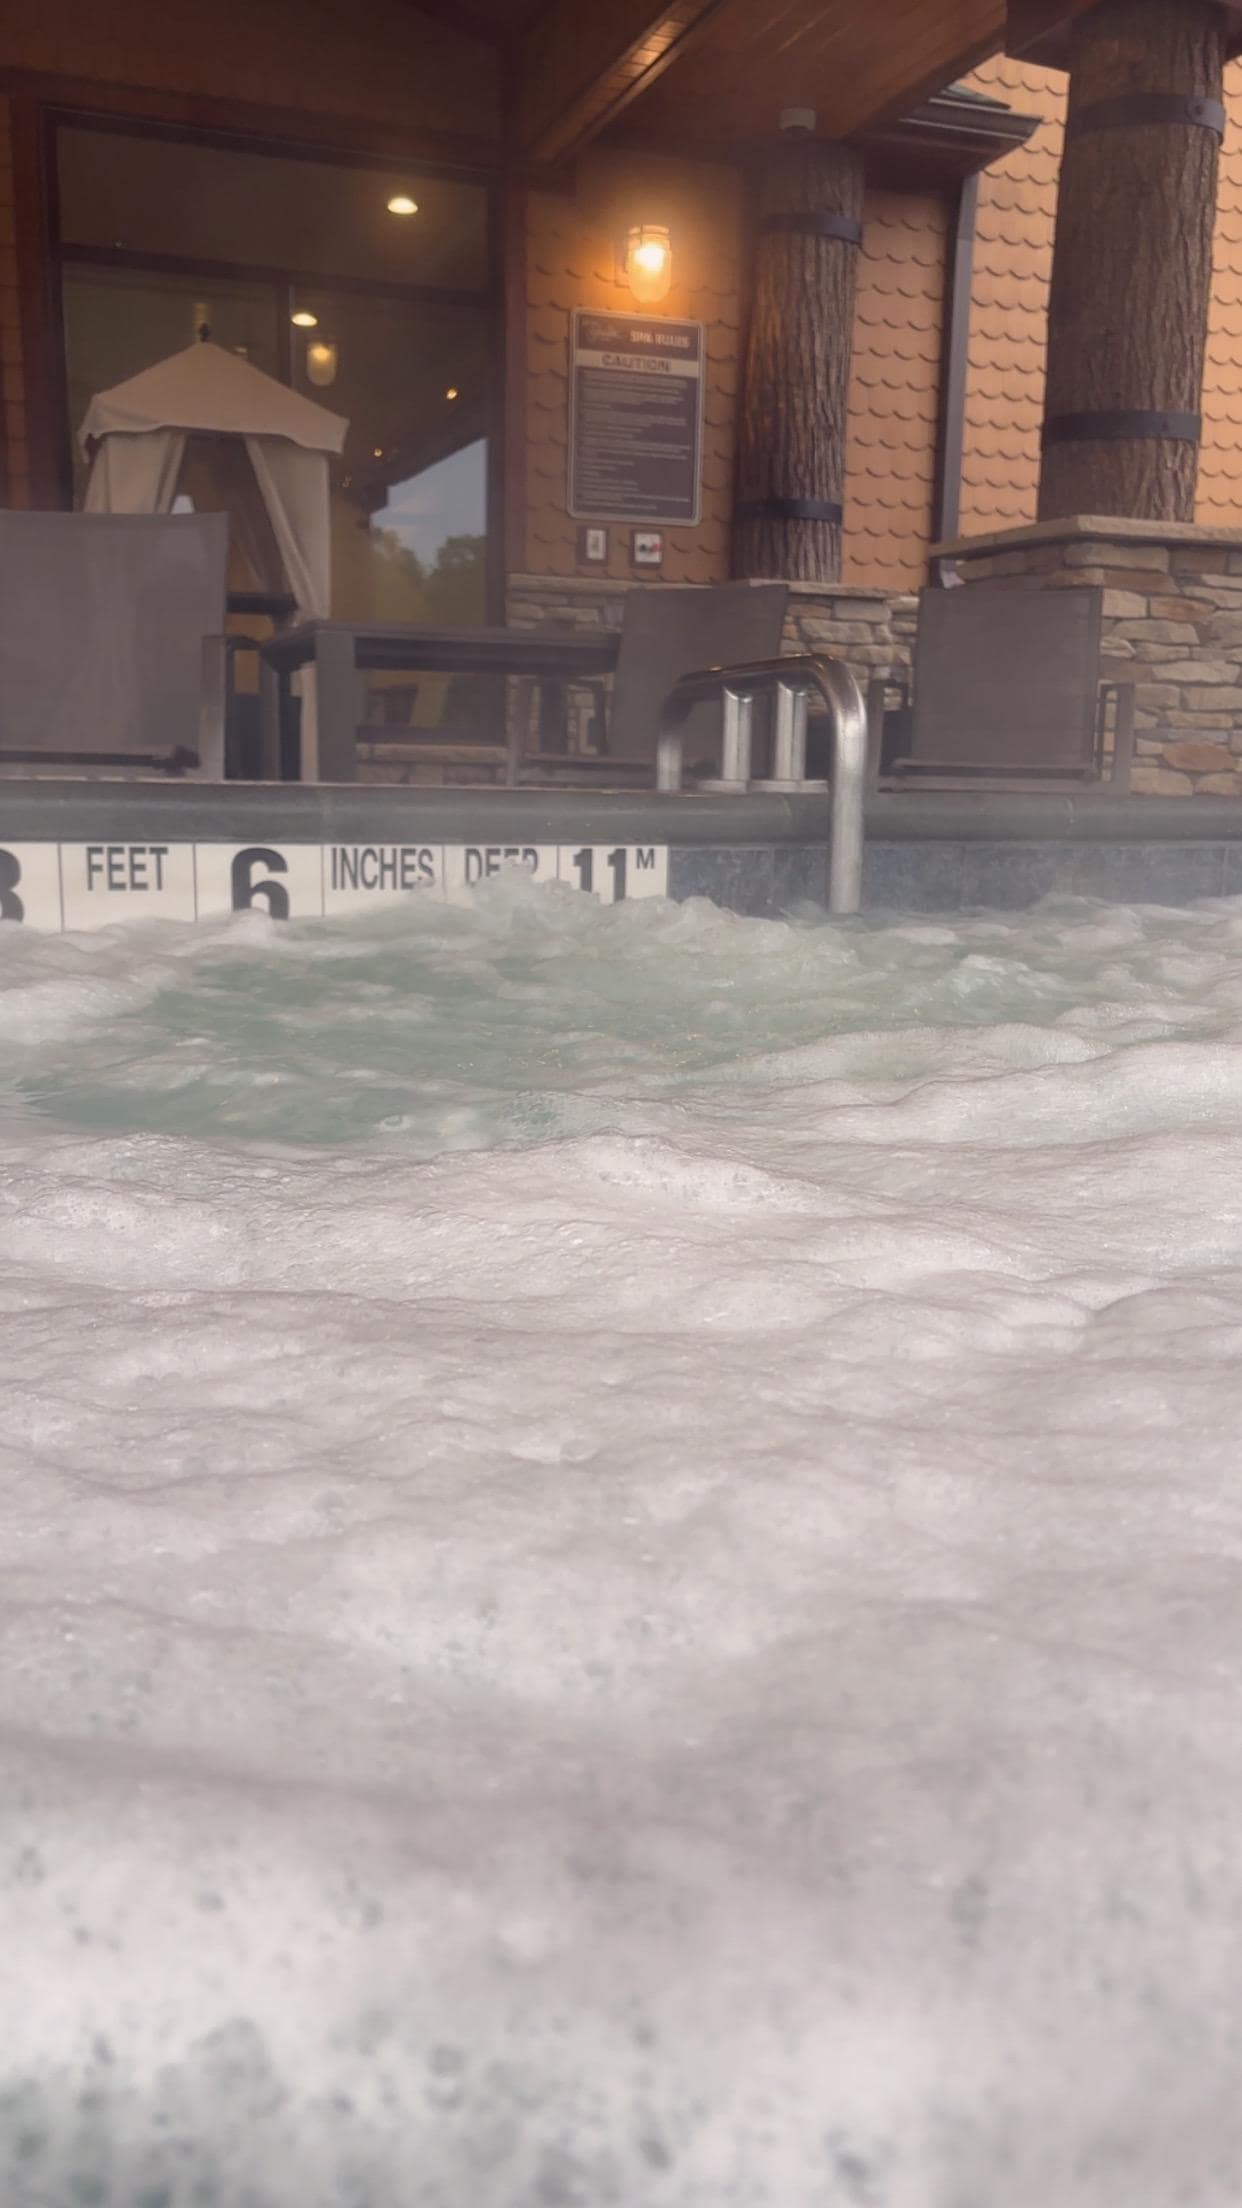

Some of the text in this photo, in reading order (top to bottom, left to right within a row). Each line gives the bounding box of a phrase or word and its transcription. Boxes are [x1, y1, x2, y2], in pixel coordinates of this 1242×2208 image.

[601, 353, 670, 373] CAUTION
[86, 847, 168, 891] FEET
[230, 847, 290, 921] 6
[331, 847, 434, 890] INCHES
[463, 847, 538, 884] DEP
